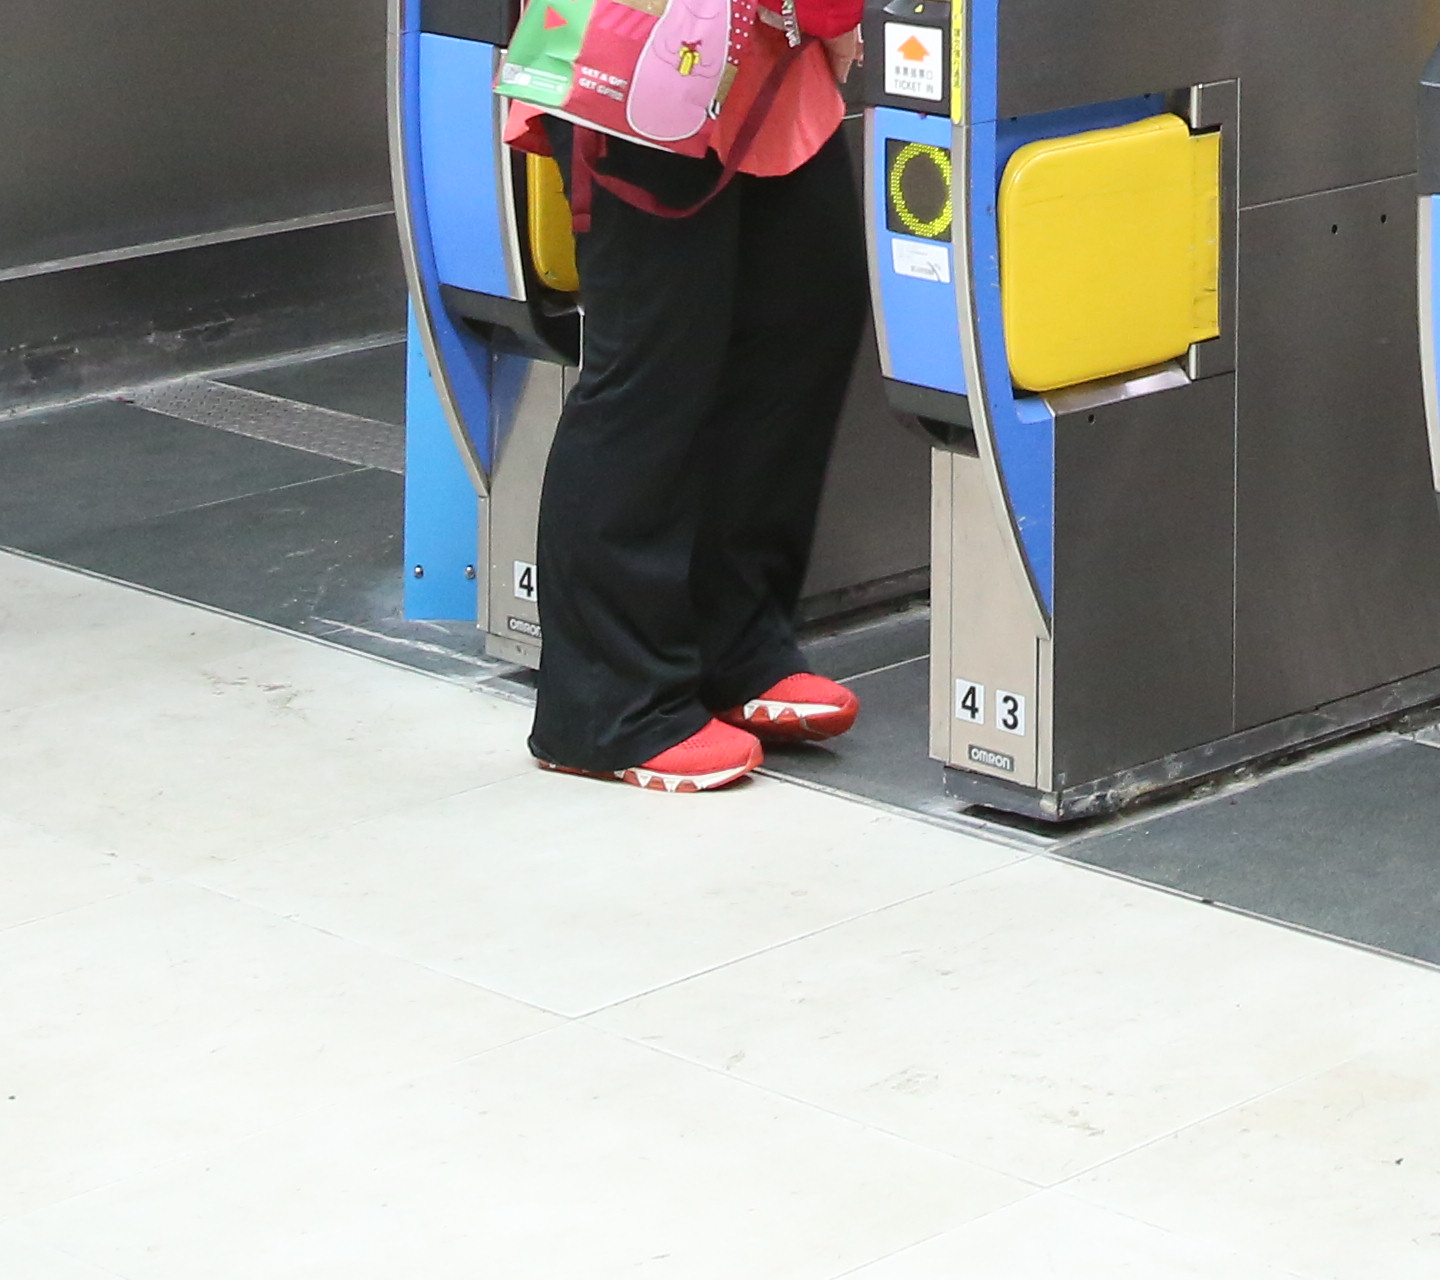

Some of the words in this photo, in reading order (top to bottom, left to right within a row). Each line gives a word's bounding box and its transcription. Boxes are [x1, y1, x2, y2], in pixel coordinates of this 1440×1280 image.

[894, 80, 922, 93] TICKET
[926, 83, 934, 94] IN
[519, 567, 534, 597] 4
[961, 685, 979, 719] 4
[1002, 696, 1019, 730] 3
[971, 748, 1012, 770] OMRON
